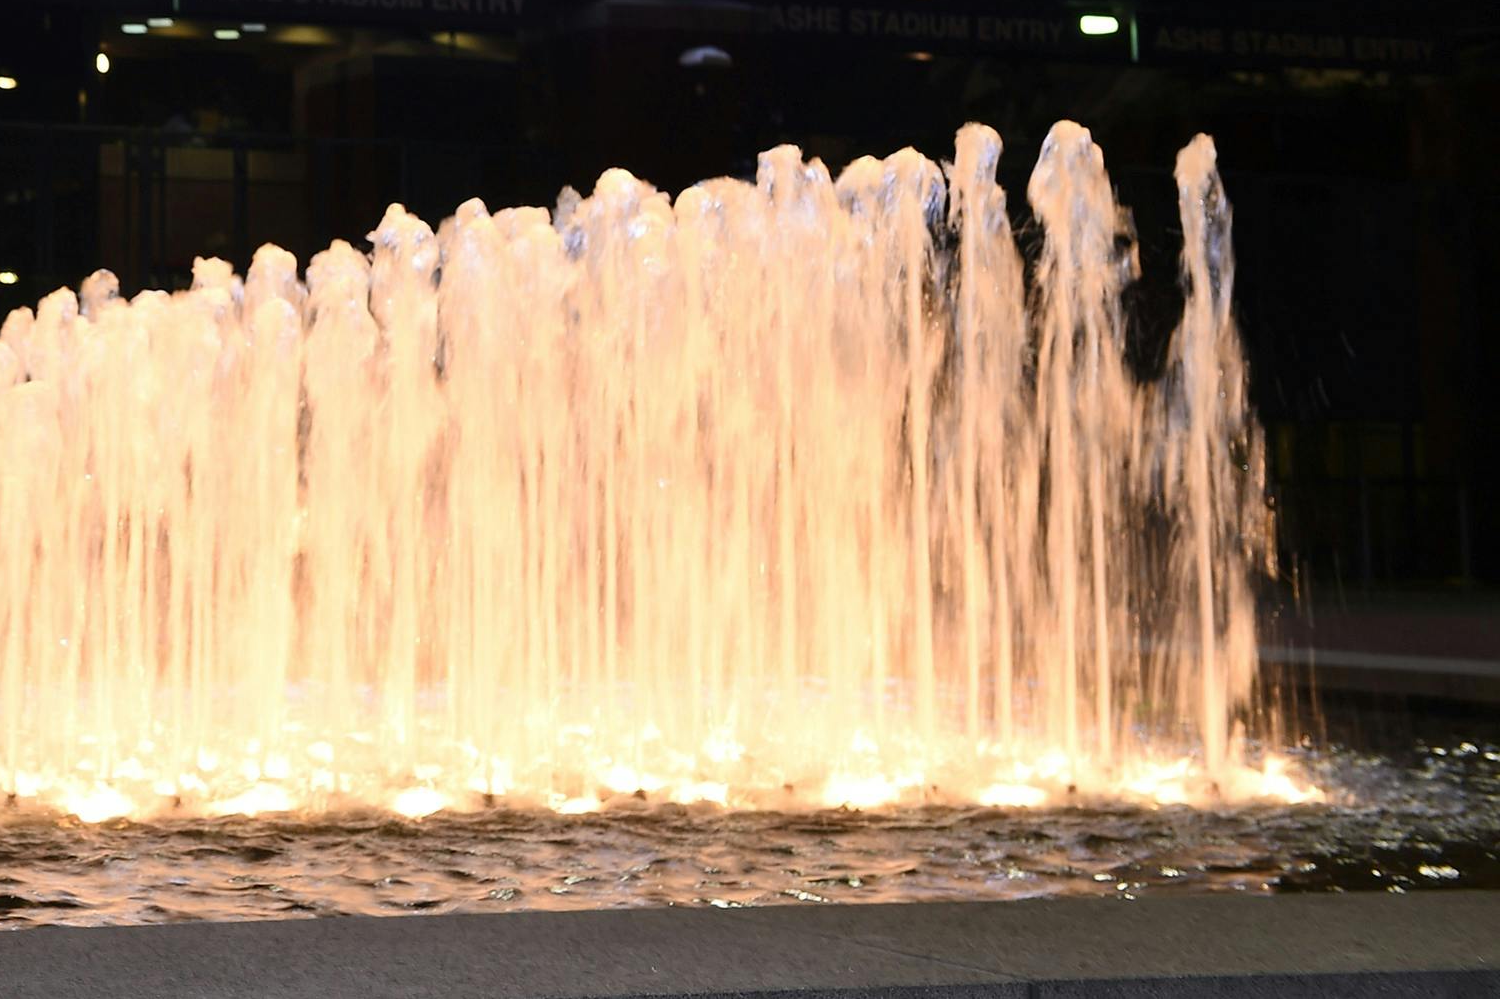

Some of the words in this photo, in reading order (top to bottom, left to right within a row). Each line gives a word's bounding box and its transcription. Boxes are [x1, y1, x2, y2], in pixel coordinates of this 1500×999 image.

[770, 4, 840, 33] ASHE
[849, 8, 969, 40] STADIUM
[977, 16, 1064, 44] ENTRY
